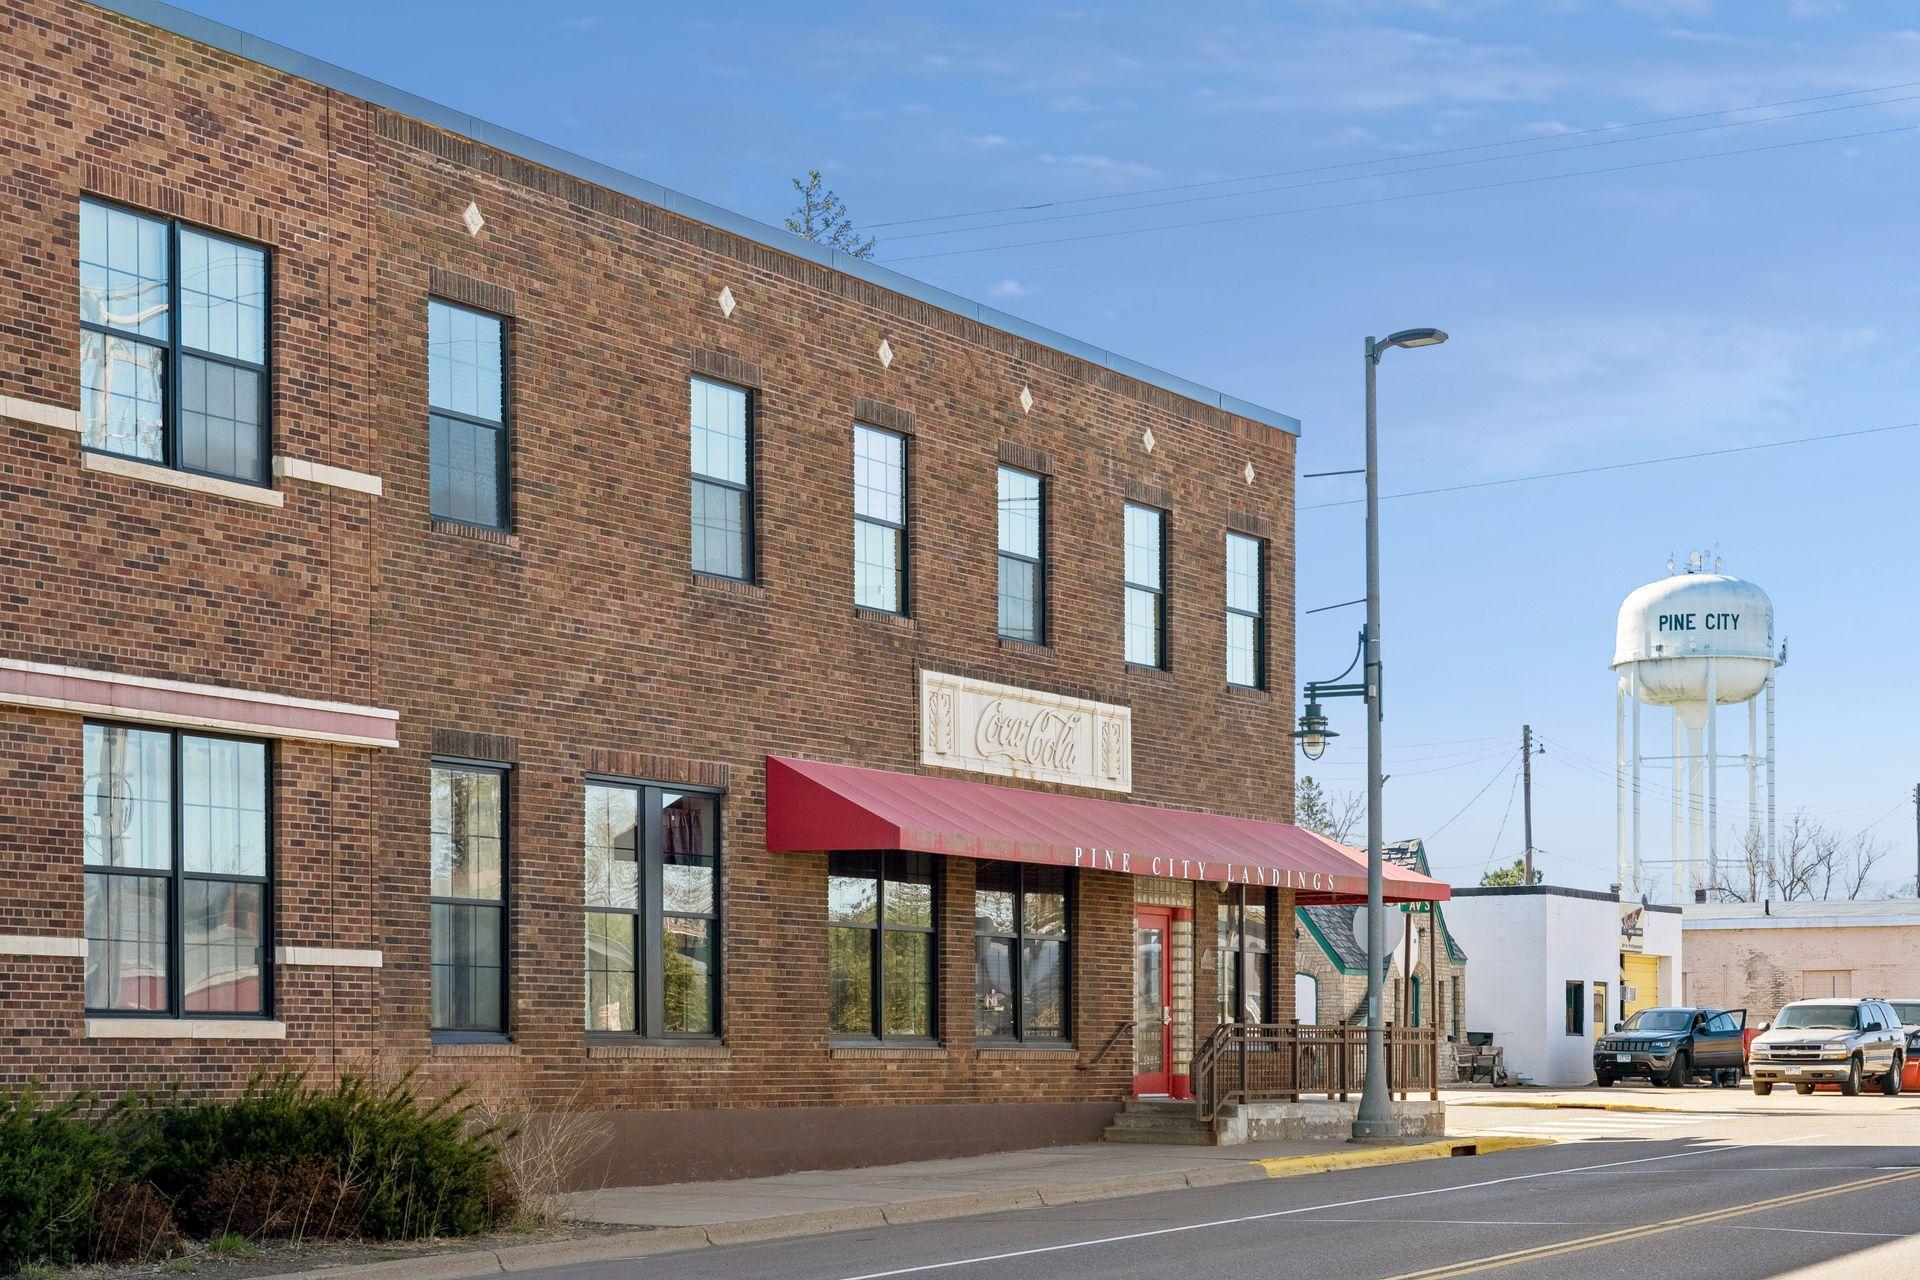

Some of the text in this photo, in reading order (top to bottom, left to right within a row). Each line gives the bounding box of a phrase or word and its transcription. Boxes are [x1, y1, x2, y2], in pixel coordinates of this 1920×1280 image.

[1658, 612, 1740, 632] PINE CITY
[1074, 846, 1334, 891] PINE CITY LANDINGS
